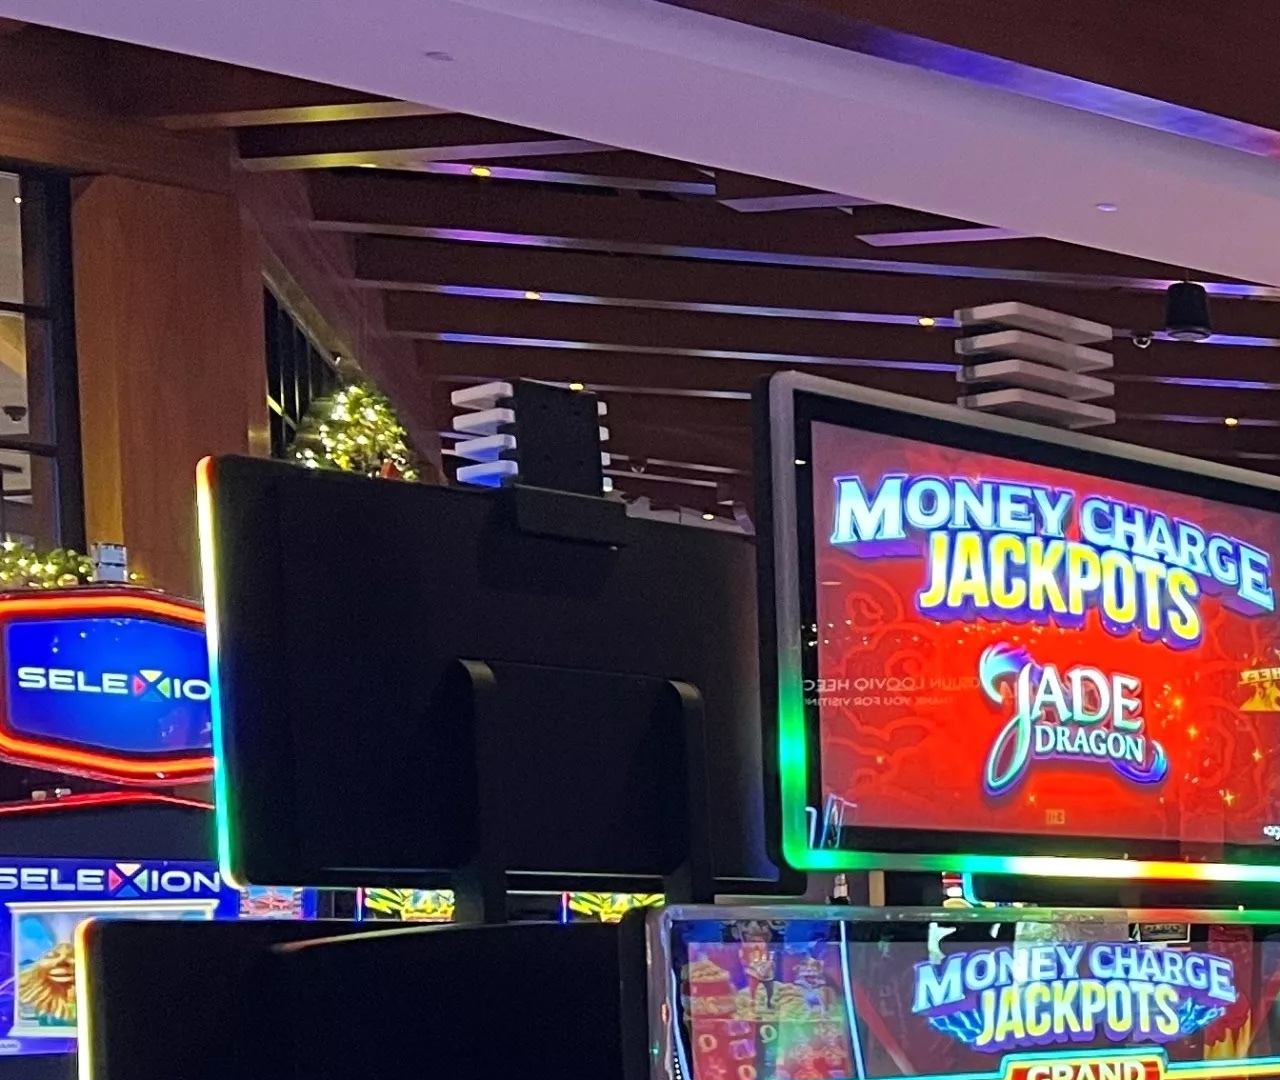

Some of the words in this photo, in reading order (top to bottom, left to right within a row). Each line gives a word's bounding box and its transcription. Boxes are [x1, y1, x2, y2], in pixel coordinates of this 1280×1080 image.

[831, 476, 1073, 545] MONEY
[1080, 497, 1274, 610] CHARGE
[919, 531, 1202, 642] JACKPOTS
[18, 667, 212, 701] SELEXIO
[982, 642, 1145, 796] JADE
[1034, 726, 1145, 764] DRAGON
[912, 944, 1083, 1014] MONEY
[1089, 945, 1237, 1003] CHARGE
[975, 979, 1180, 1047] JACKPOTS
